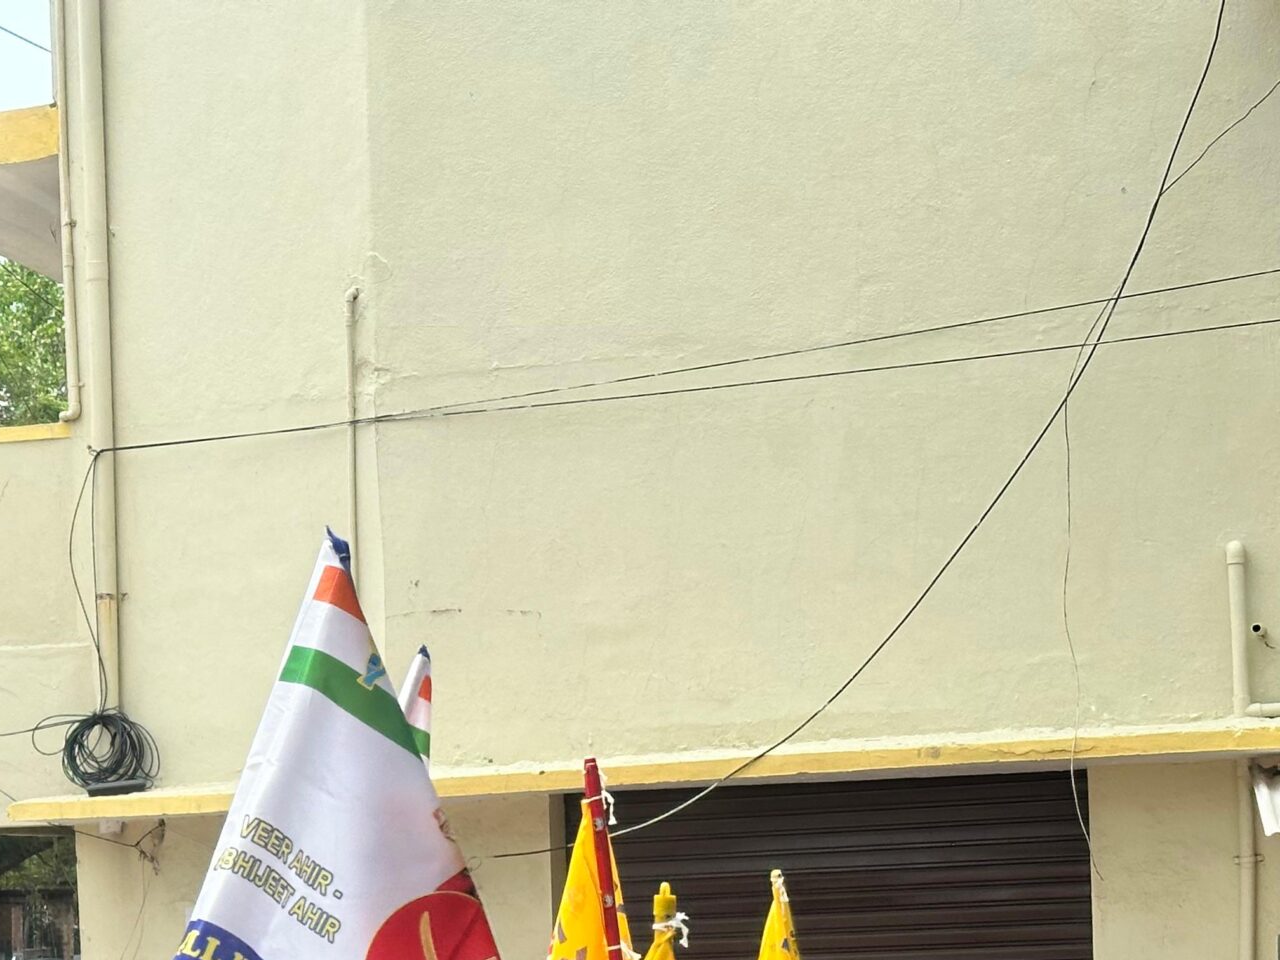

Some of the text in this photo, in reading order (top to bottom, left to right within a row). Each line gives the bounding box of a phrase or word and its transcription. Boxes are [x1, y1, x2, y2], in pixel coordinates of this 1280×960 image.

[214, 847, 342, 944] BHIJEET AHIR
[240, 814, 294, 865] VEER
[288, 849, 334, 897] AHIR
